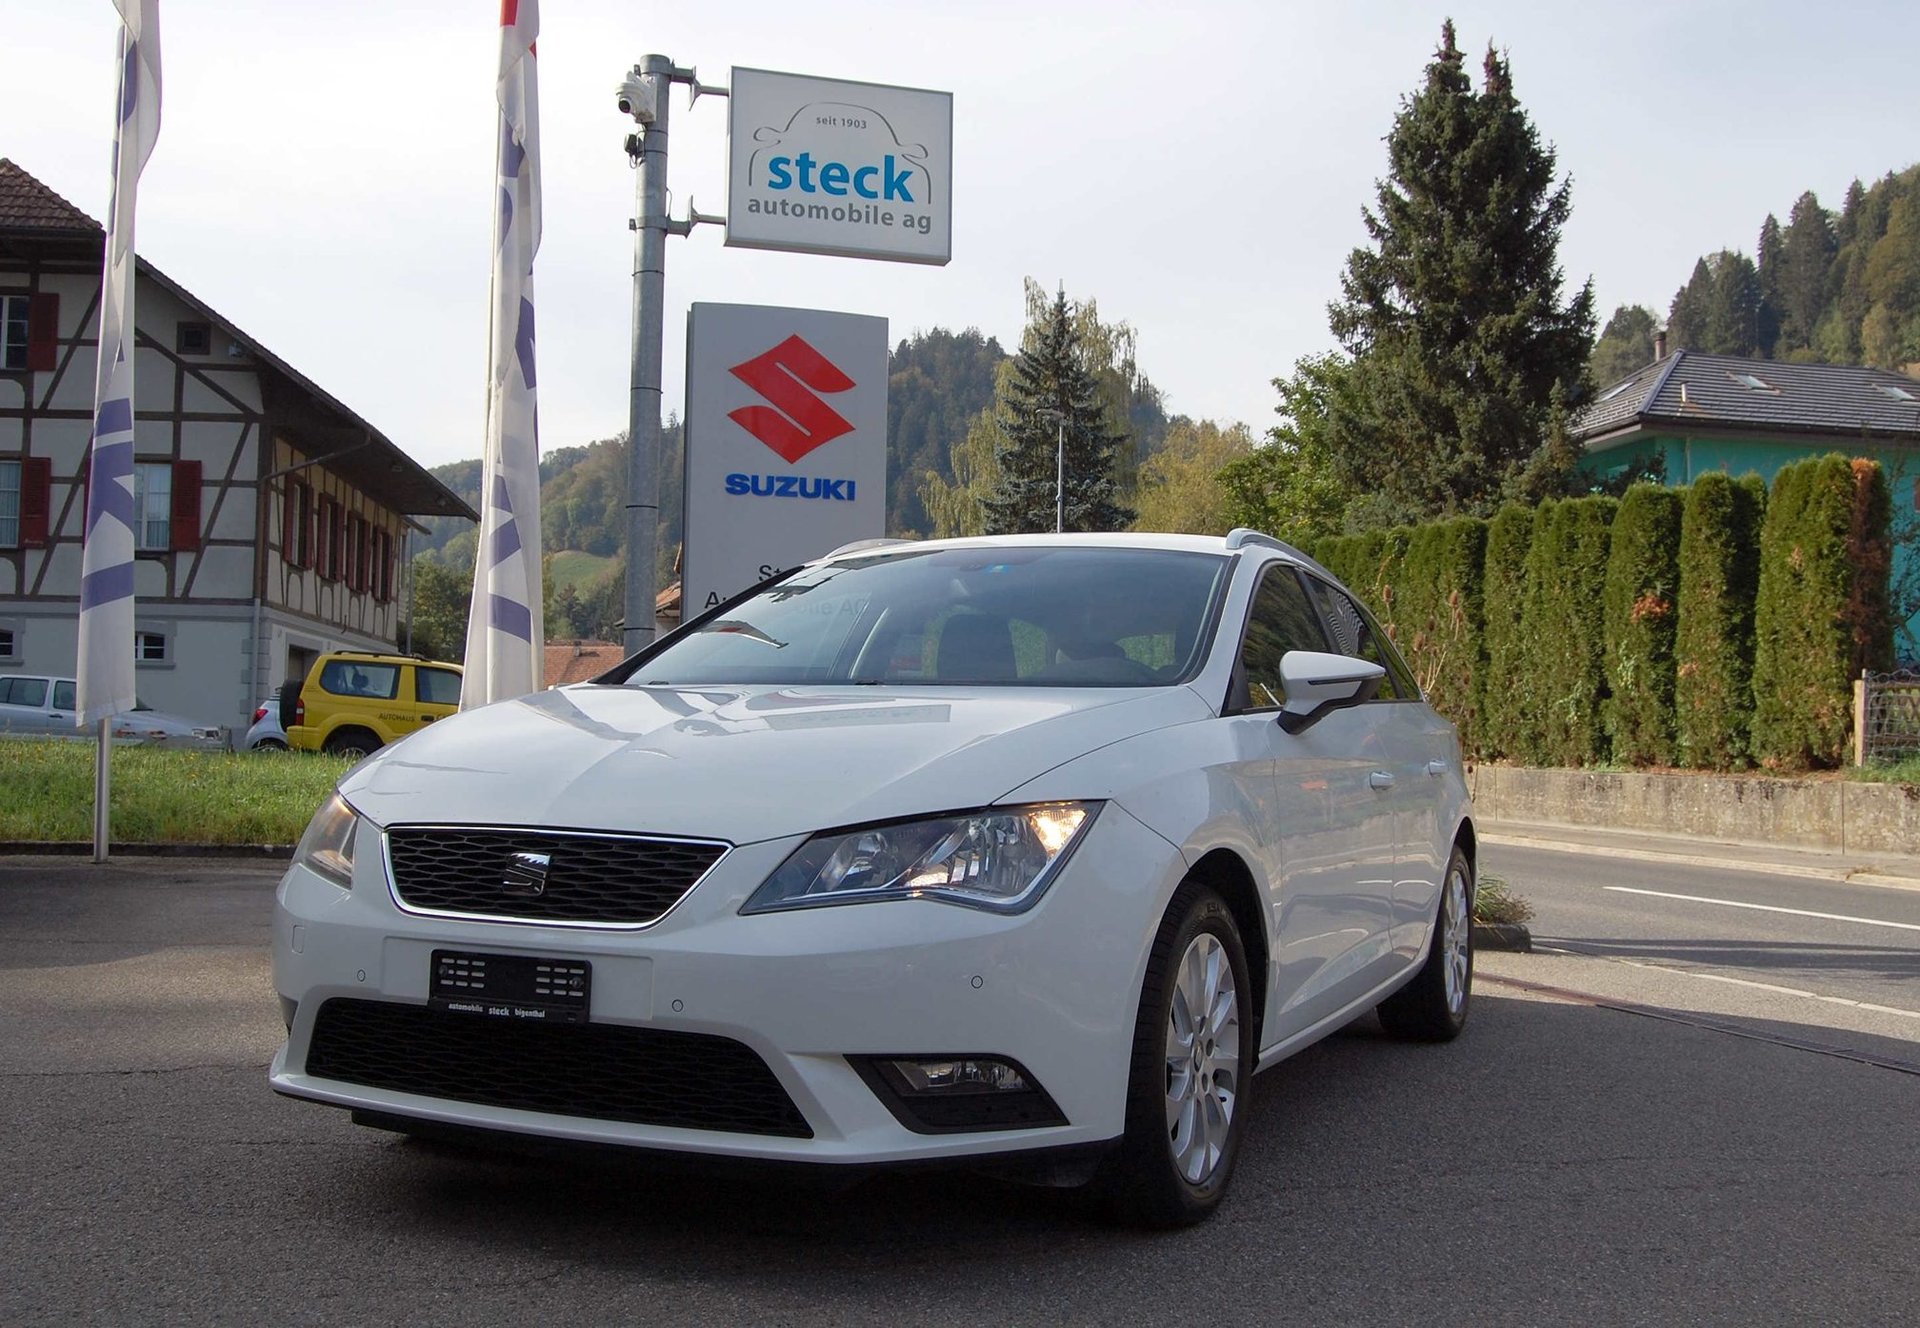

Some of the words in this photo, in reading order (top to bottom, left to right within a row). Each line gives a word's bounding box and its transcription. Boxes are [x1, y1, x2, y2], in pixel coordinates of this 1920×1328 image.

[816, 116, 837, 127] seit
[841, 117, 867, 129] 1903
[769, 152, 914, 203] steck
[748, 197, 894, 227] automobile
[903, 212, 931, 234] ag
[725, 473, 856, 501] SUZUKI
[379, 713, 415, 722] AUTOHAUS
[489, 1007, 510, 1016] steck
